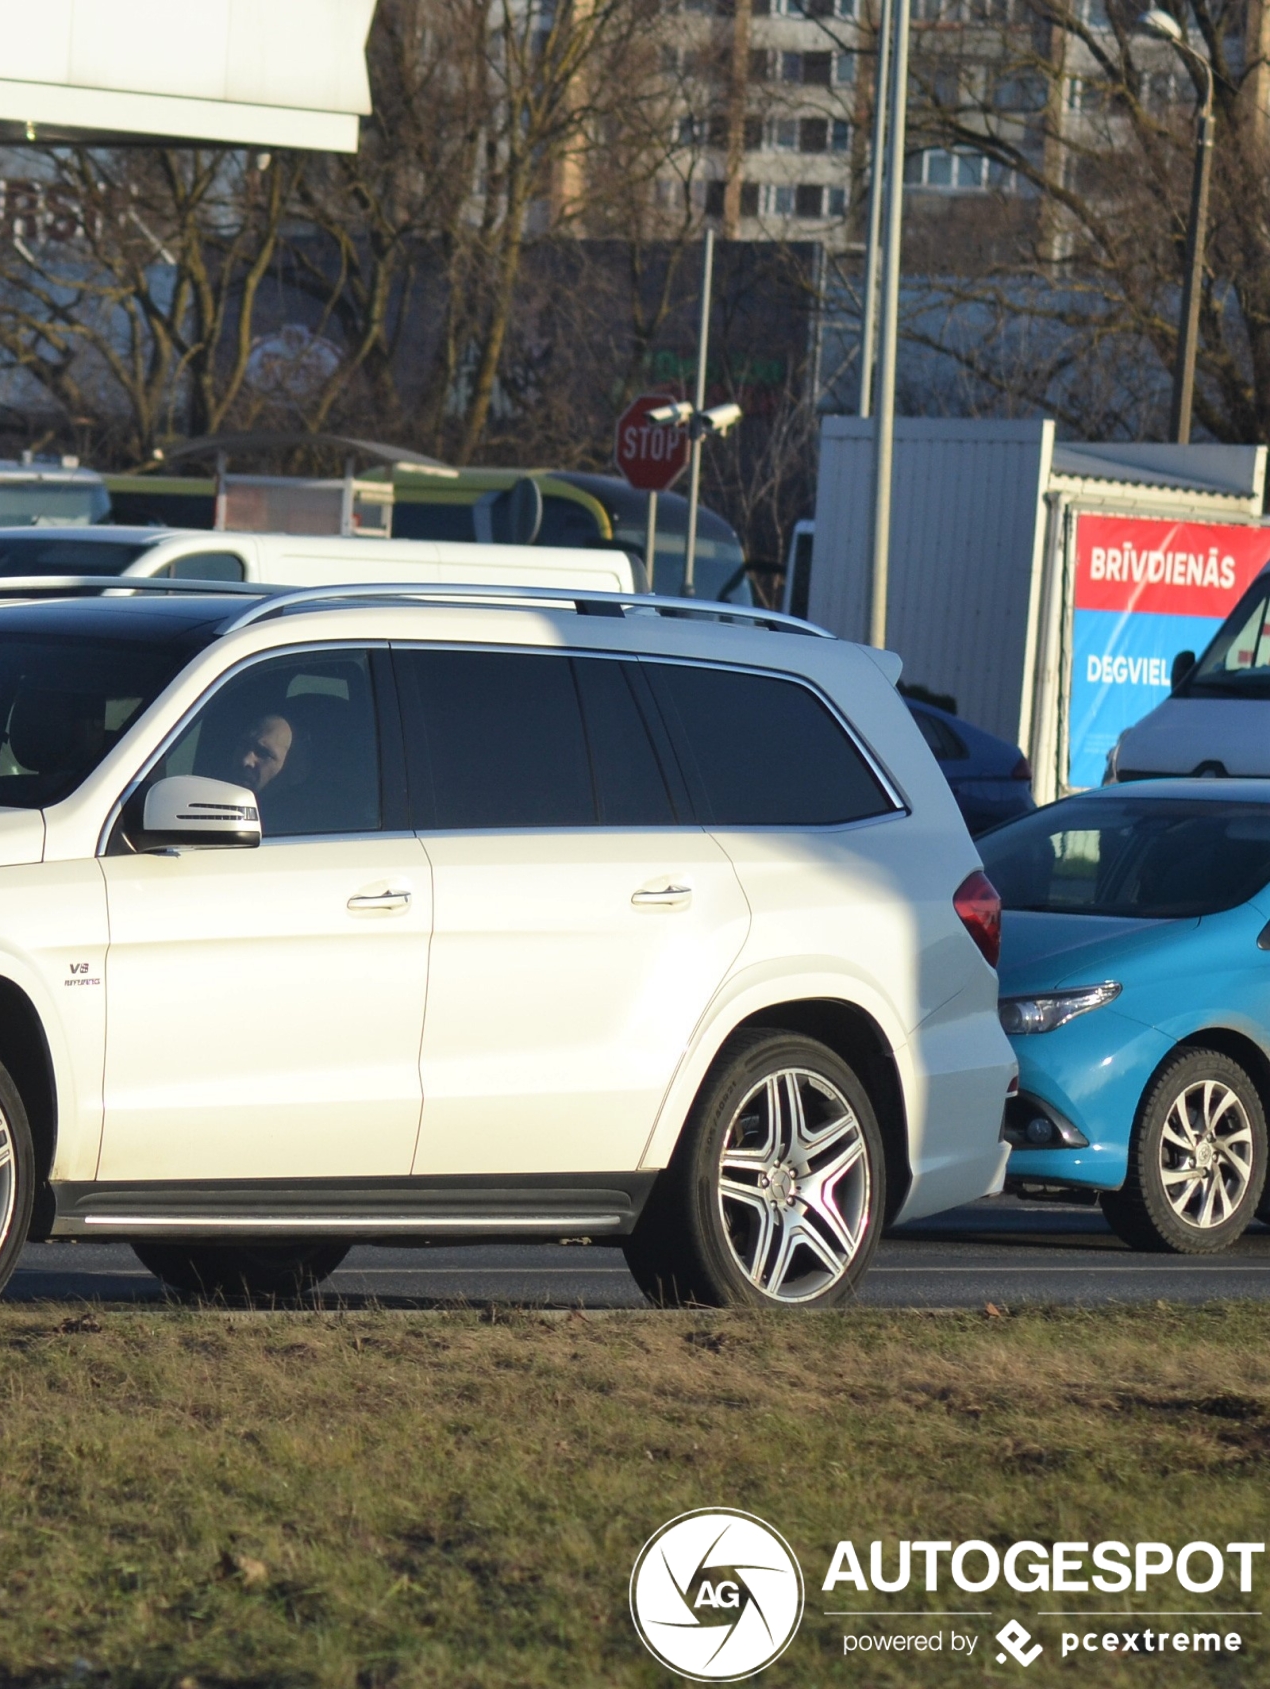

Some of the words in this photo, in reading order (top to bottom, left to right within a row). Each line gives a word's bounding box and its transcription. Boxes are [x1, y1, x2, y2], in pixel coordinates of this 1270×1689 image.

[623, 424, 680, 461] STOP
[1089, 542, 1236, 589] BRĪVDIENĀS
[1086, 654, 1171, 687] DEGVIEL
